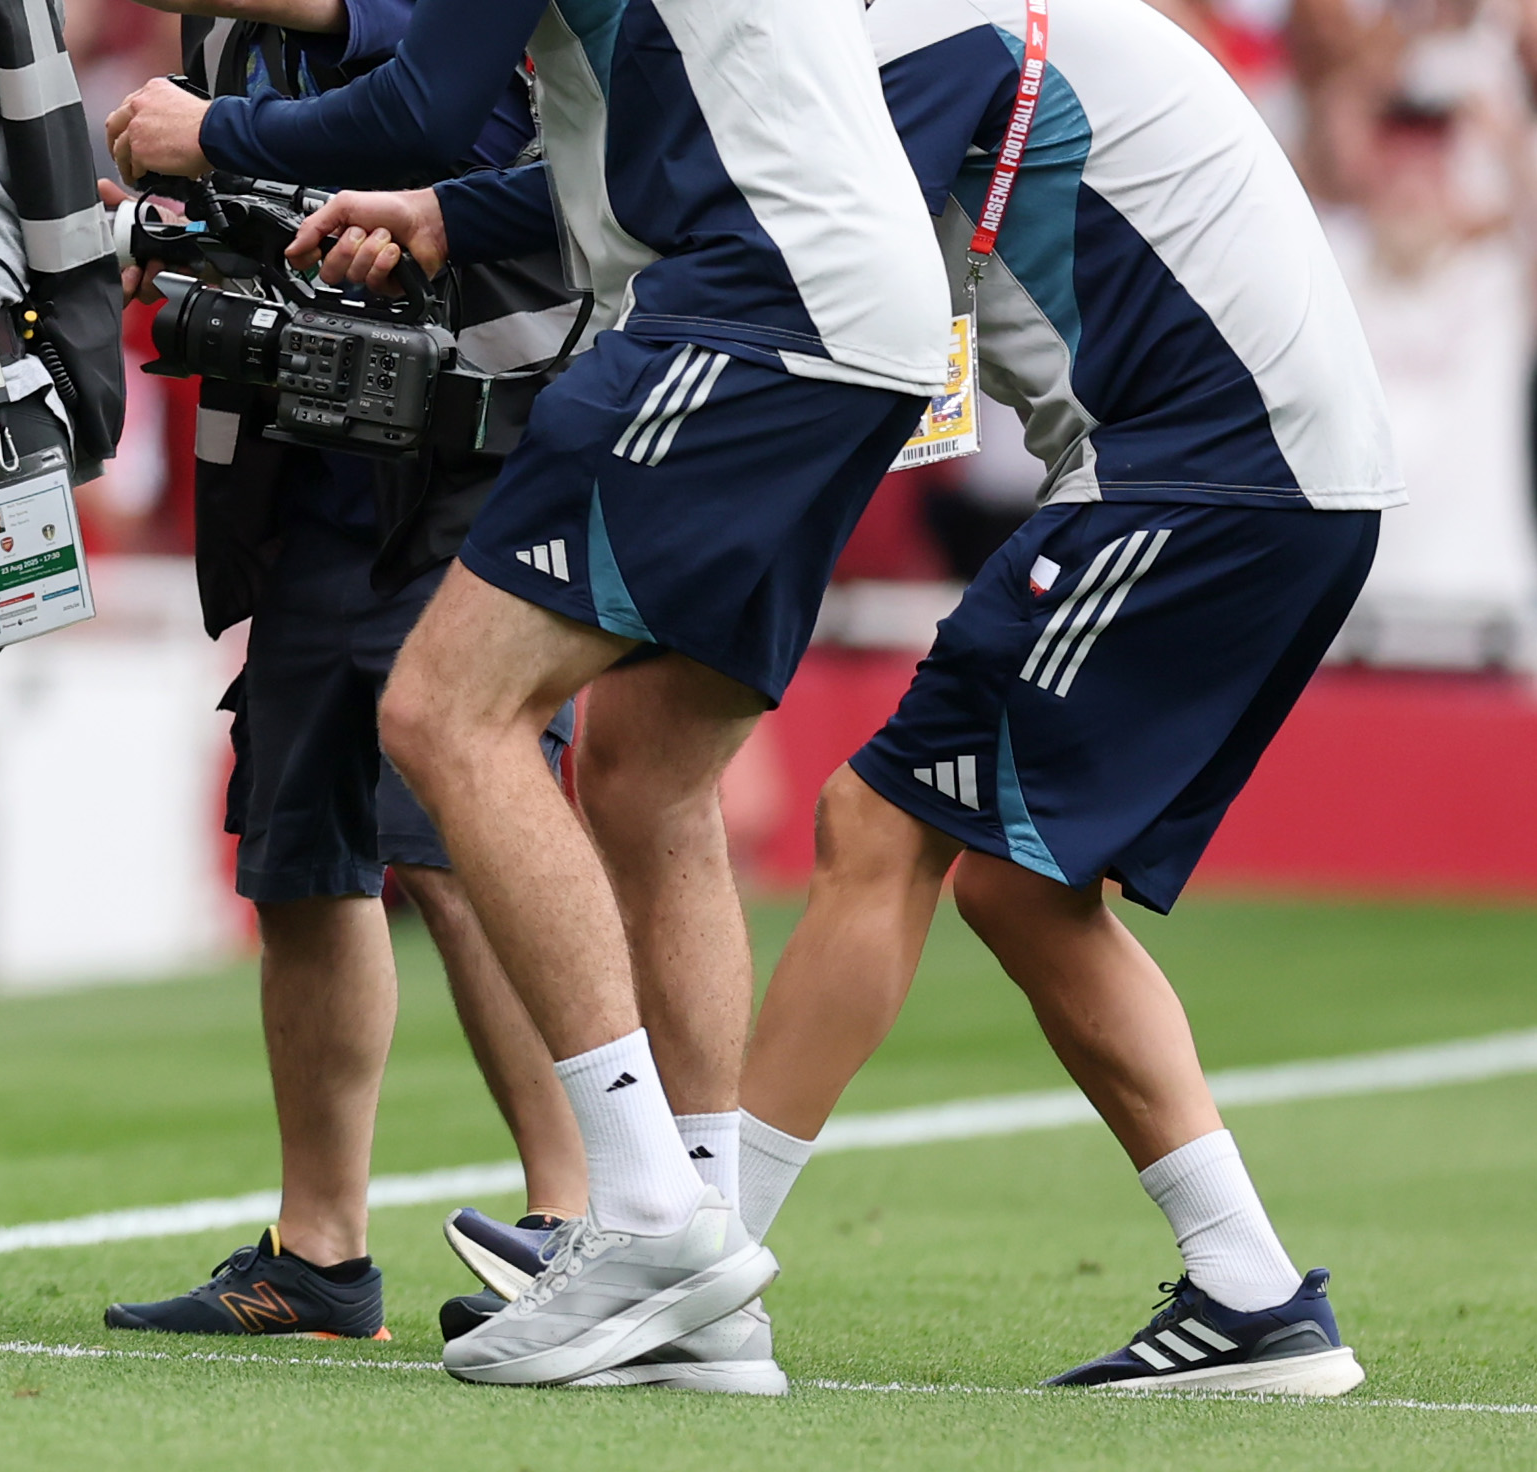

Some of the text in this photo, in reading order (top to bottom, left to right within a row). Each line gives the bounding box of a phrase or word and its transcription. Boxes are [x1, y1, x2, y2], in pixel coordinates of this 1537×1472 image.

[981, 58, 1044, 232] ARSENAL FOOTBALL CLUB
[210, 317, 221, 326] G
[371, 331, 410, 345] SONY
[1, 566, 9, 575] 23
[9, 563, 23, 573] Aug
[23, 558, 39, 569] 2025
